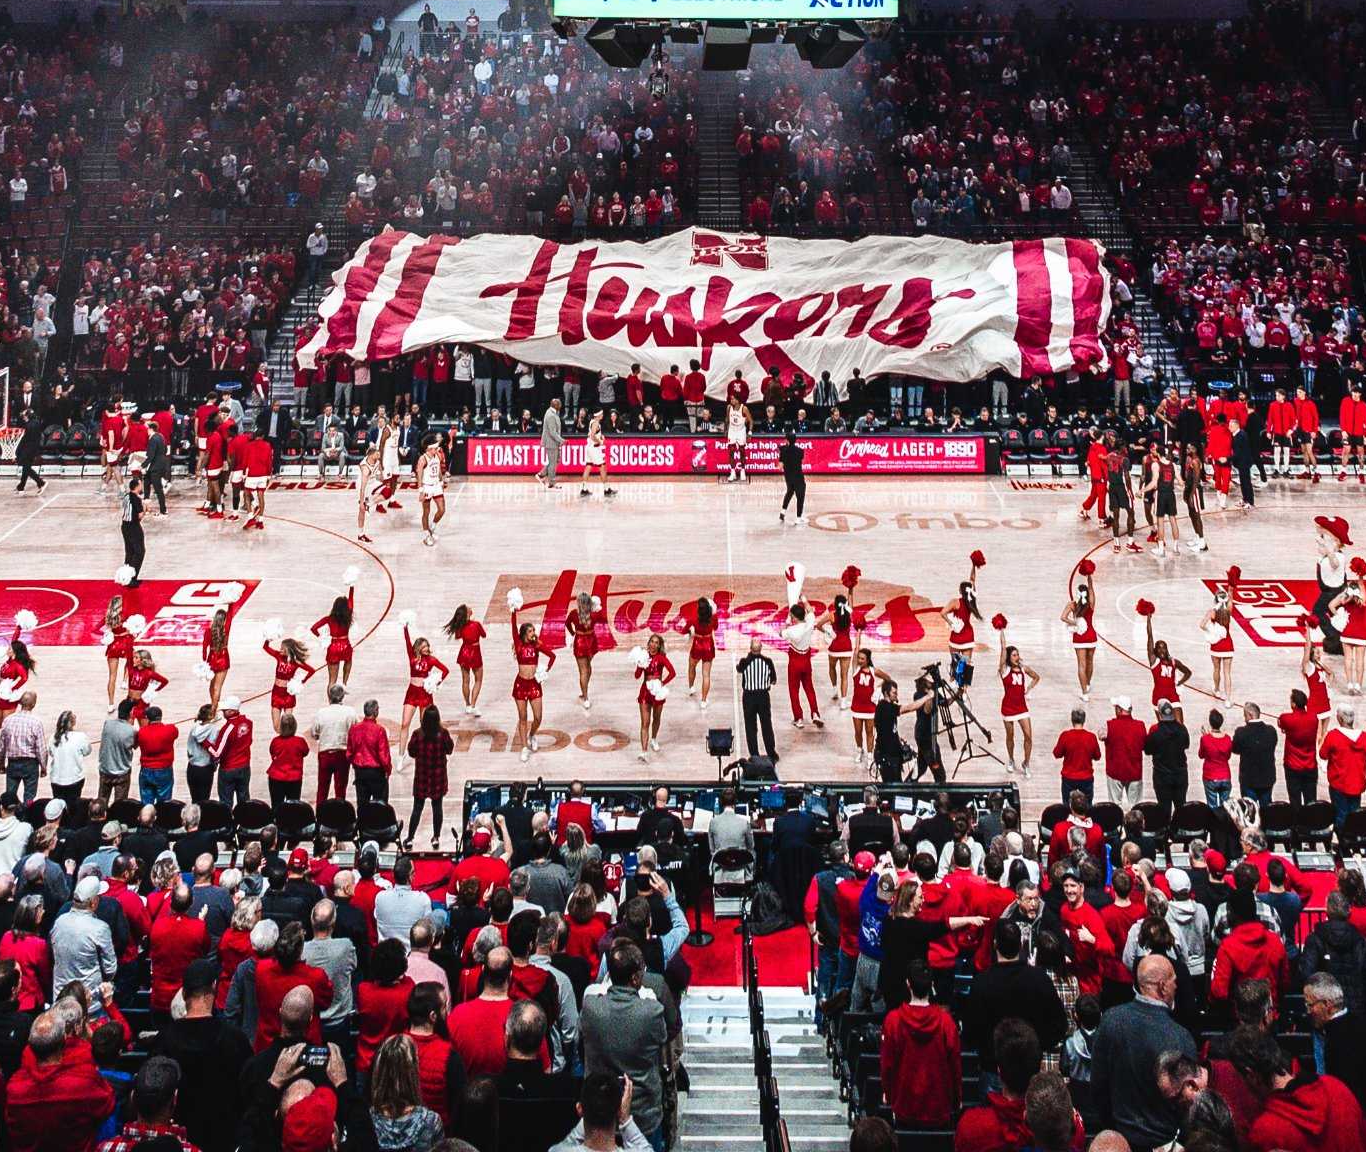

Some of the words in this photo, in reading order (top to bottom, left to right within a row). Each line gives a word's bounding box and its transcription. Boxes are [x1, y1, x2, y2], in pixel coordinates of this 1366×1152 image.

[479, 238, 977, 398] Huskers
[474, 445, 483, 465] A
[486, 445, 530, 465] TOAST
[532, 443, 549, 467] TO
[610, 445, 674, 465] SUCCESS
[840, 440, 889, 459] Cornhead
[893, 442, 934, 456] LAGER
[944, 441, 977, 457] 1890
[890, 512, 1041, 530] fnbo
[859, 671, 873, 686] N
